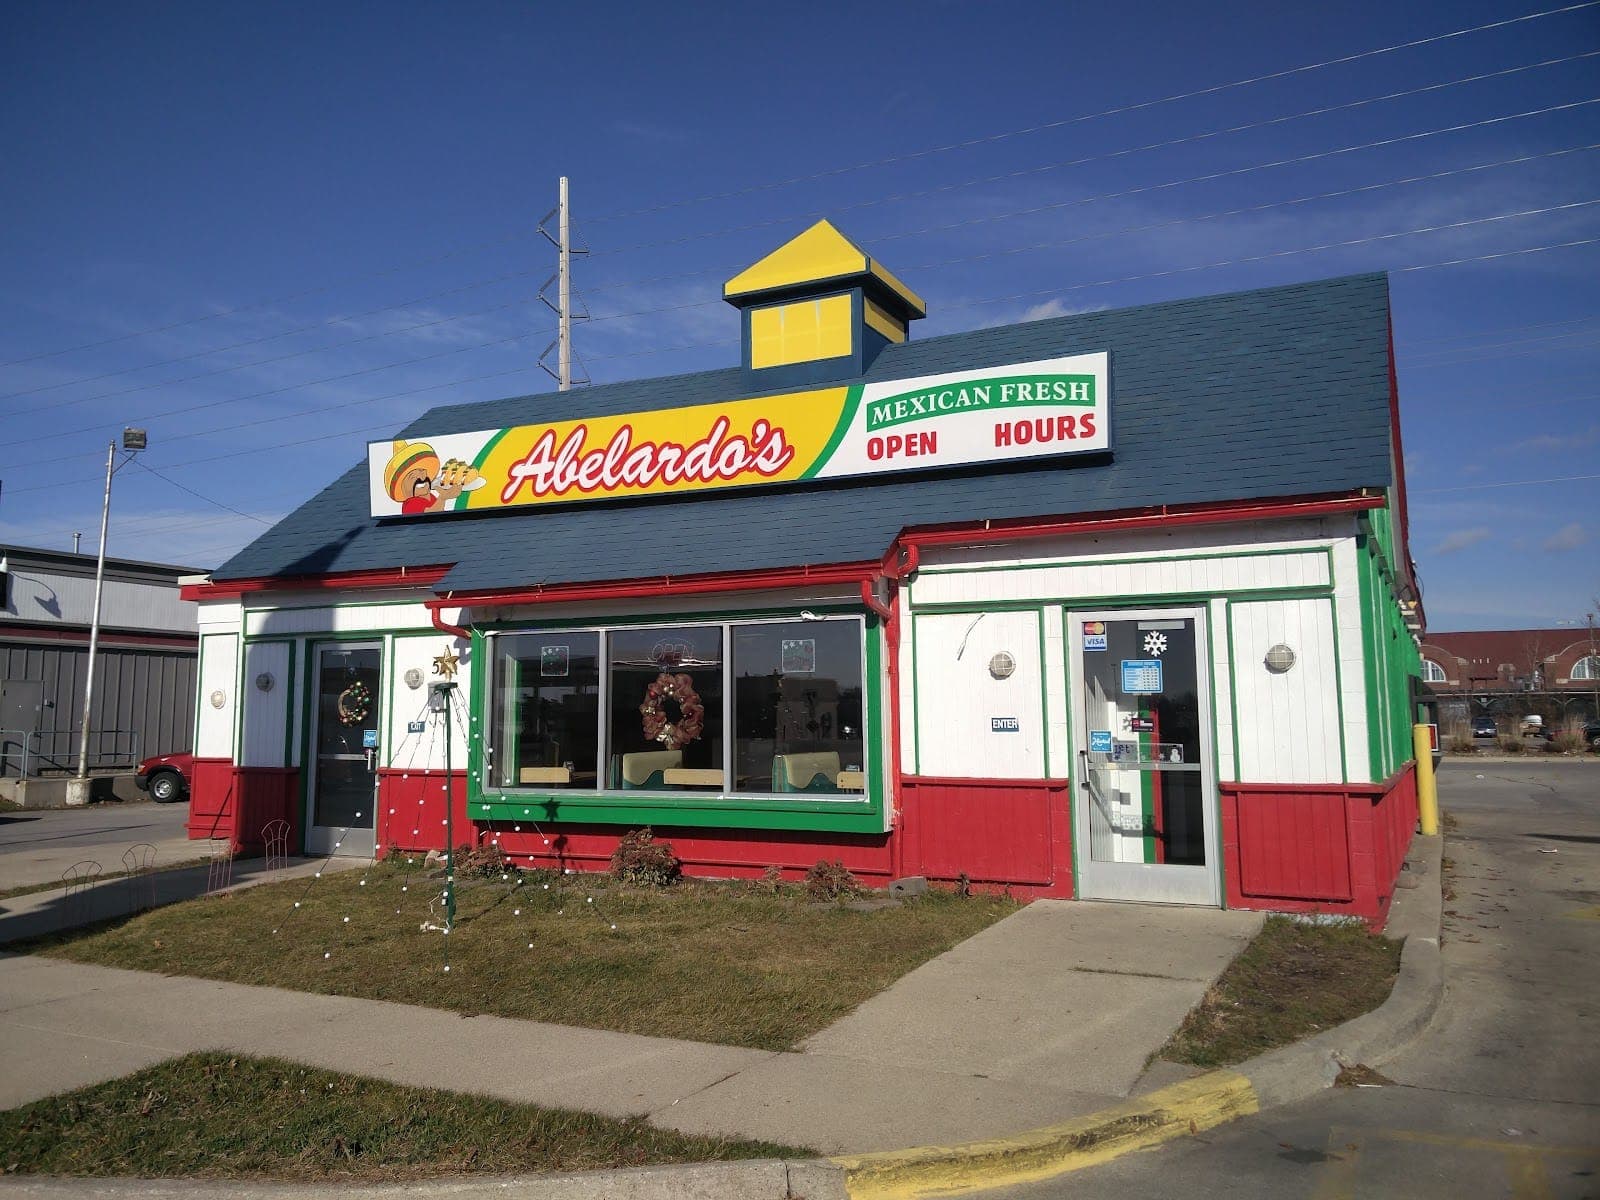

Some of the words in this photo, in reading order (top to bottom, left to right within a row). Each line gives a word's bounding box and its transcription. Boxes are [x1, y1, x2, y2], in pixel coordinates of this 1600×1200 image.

[871, 386, 992, 426] MEXICAN
[999, 381, 1091, 403] FRESH
[501, 415, 795, 504] Abelardo's
[866, 431, 937, 461] OPEN
[994, 413, 1096, 447] HOURS
[992, 719, 1018, 729] ENTER
